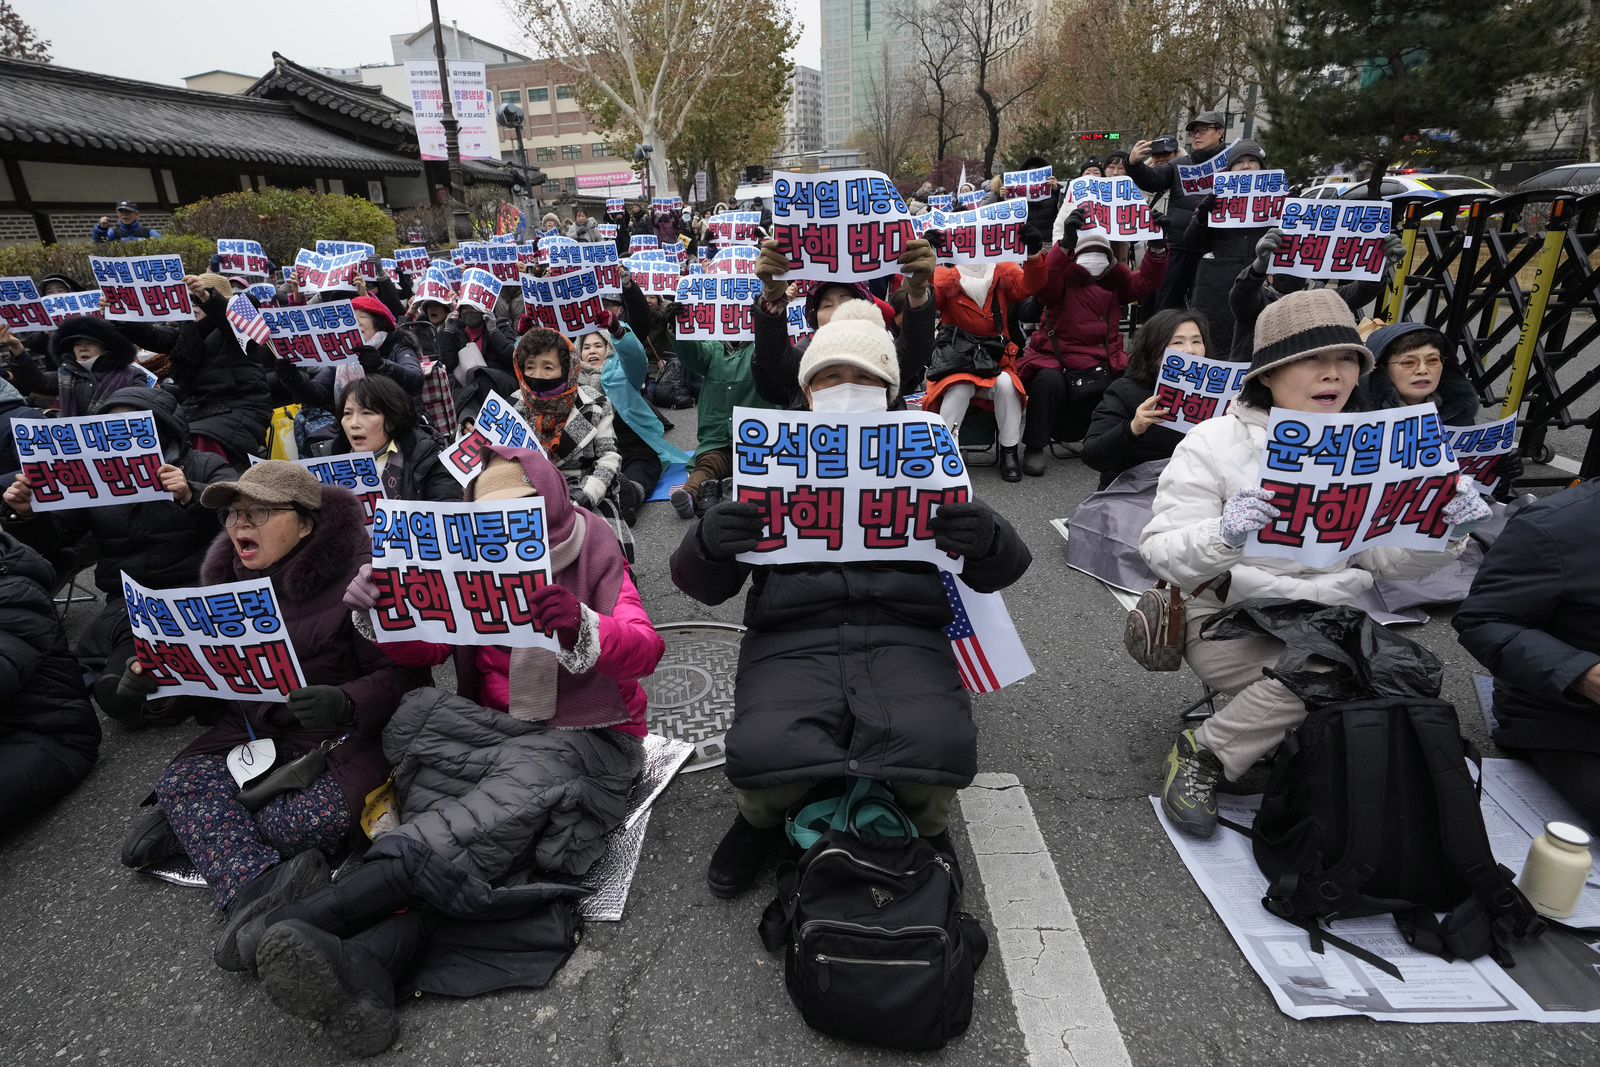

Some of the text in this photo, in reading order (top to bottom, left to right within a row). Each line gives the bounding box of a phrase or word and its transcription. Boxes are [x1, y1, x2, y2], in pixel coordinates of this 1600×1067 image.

[1004, 172, 1028, 184] 윤석열
[1179, 165, 1214, 179] 윤석열
[1213, 175, 1252, 194] 윤석열
[774, 177, 908, 218] 윤석열 대통령
[1029, 182, 1051, 199] 반대
[1072, 179, 1144, 202] 윤석열 대통
[933, 211, 977, 227] 윤석열
[980, 200, 1027, 221] 대통령
[1077, 201, 1111, 235] 탄핵
[1211, 196, 1248, 223] 탄핵
[1282, 203, 1392, 233] 윤석열 대통령
[709, 223, 759, 241] 탄핵 반대
[774, 219, 916, 273] 탄핵 반대
[937, 222, 1026, 258] 탄핵 반대
[220, 254, 245, 271] 탄핵
[247, 256, 269, 274] 반대
[297, 251, 333, 271] 윤석열
[463, 247, 518, 261] 윤석열 대통령
[549, 244, 618, 263] 윤석열 대통령
[1273, 233, 1386, 274] 탄핵 반대
[92, 258, 184, 283] 윤석열 대통령
[295, 265, 327, 288] 탄핵
[327, 263, 358, 286] 반대
[472, 270, 502, 294] 대통령
[492, 263, 520, 282] 반대
[652, 273, 679, 292] 반대
[0, 280, 38, 301] 통령
[101, 283, 192, 316] 탄핵 반대
[428, 282, 450, 301] 반대
[468, 284, 496, 310] 반대
[521, 270, 598, 302] 윤석열 대통령
[677, 278, 718, 300] 윤석열
[0, 302, 52, 327] 반대
[43, 292, 104, 314] 윤석열 대통
[525, 295, 601, 332] 탄핵 반대
[1519, 268, 1543, 346] POLICE
[262, 304, 357, 334] 윤석열 대통령
[677, 303, 716, 334] 탄핵
[271, 329, 363, 362] 탄핵 반대
[1162, 355, 1232, 393] 윤석열
[1155, 382, 1220, 424] 탄핵
[15, 416, 157, 455] 윤석열 대통령
[736, 418, 964, 479] 윤석열 대통령
[1267, 420, 1386, 476] 윤석열
[1452, 417, 1516, 453] 대통령
[22, 452, 168, 503] 탄핵 반대
[307, 457, 379, 489] 대통령
[736, 484, 844, 552] 탄핵
[1257, 470, 1461, 552] 탄핵 반대
[372, 507, 442, 561] 윤석열
[442, 507, 546, 563] 대통령
[123, 581, 281, 637] 윤석열 대통령
[372, 566, 555, 639] 탄핵 반대
[134, 637, 301, 696] 탄핵 반대
